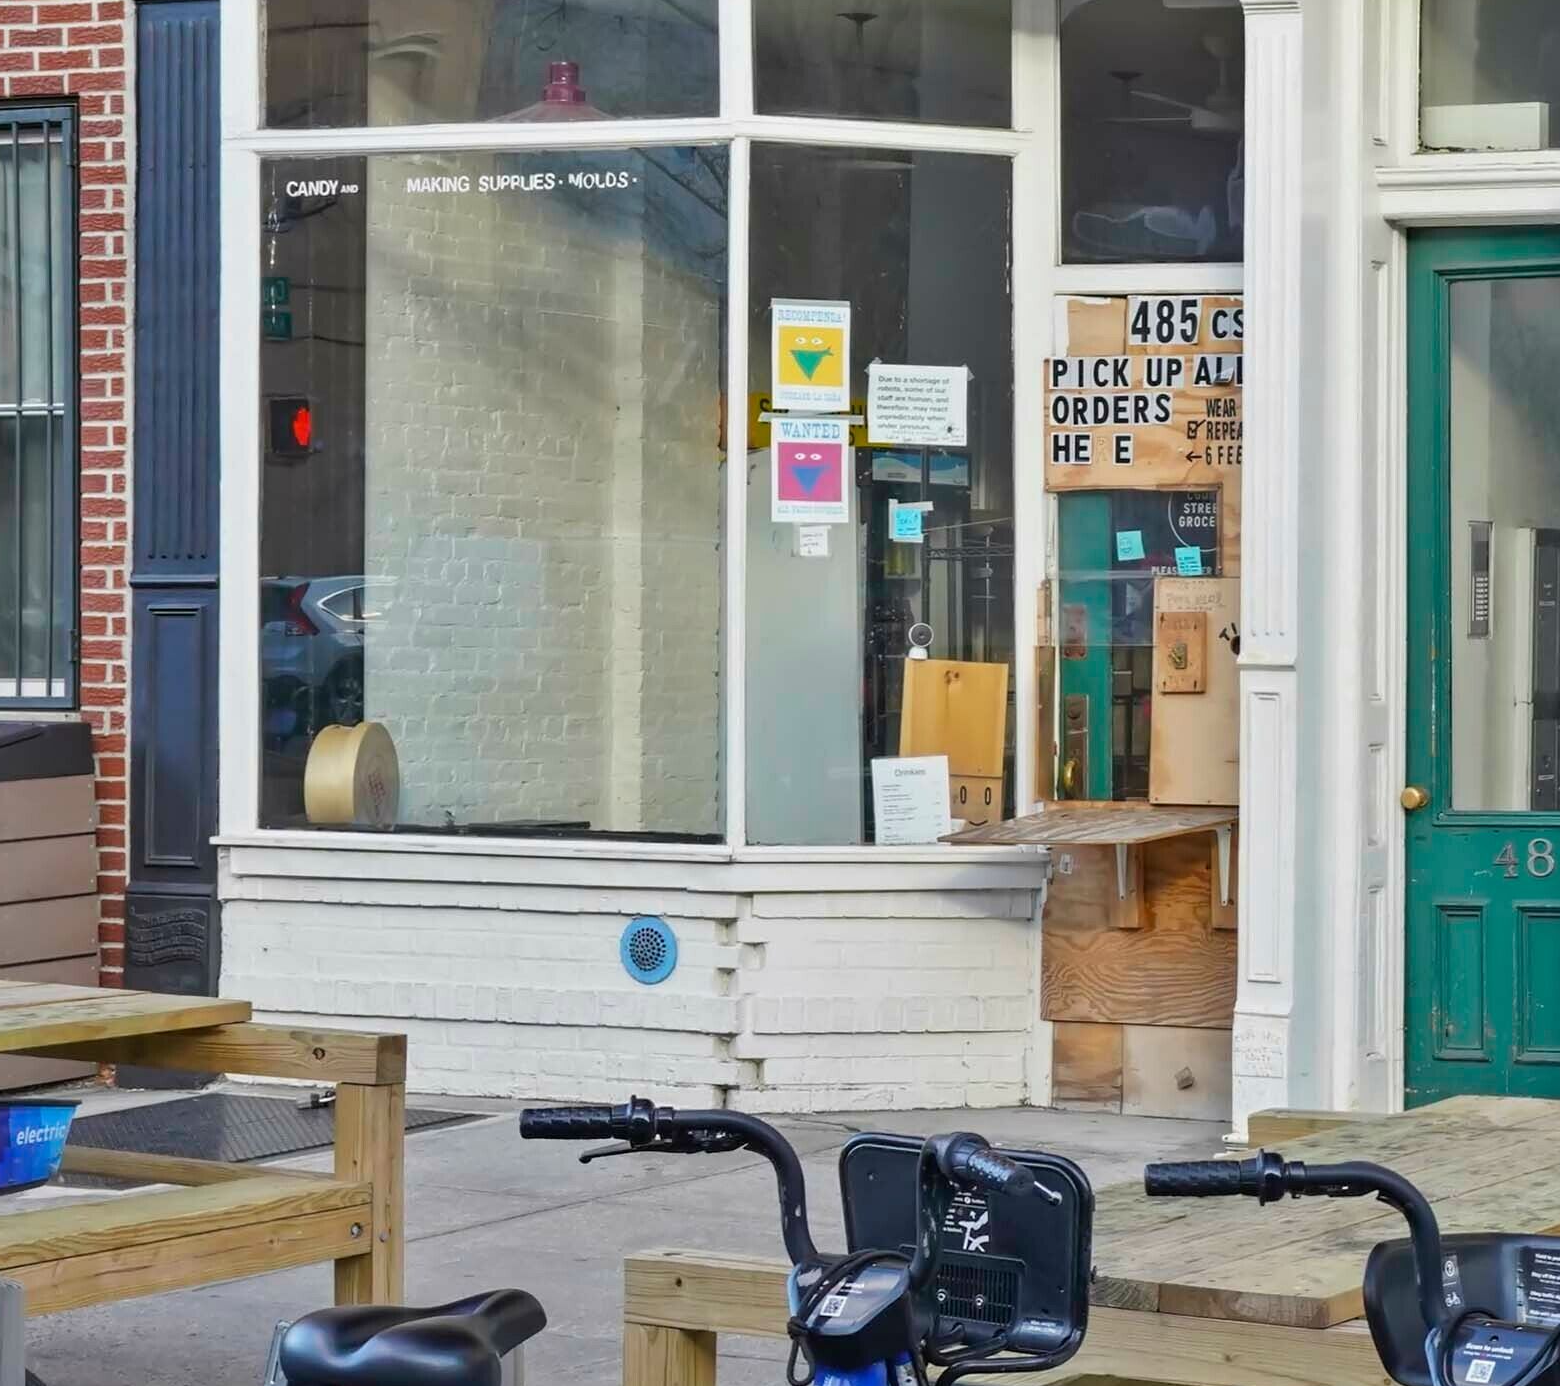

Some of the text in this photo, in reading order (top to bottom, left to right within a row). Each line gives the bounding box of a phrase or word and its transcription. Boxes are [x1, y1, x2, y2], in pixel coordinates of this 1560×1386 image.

[287, 172, 628, 197] CANDY AND MAKING SUPPLIES MOLDS
[1131, 300, 1198, 343] 485
[1052, 358, 1129, 387] PICK
[1147, 358, 1182, 386] UP
[1052, 394, 1171, 425] ORDERS
[1206, 398, 1236, 417] WEAR
[781, 422, 841, 438] WANTED
[1206, 447, 1212, 465] 6
[14, 1123, 66, 1147] electric
